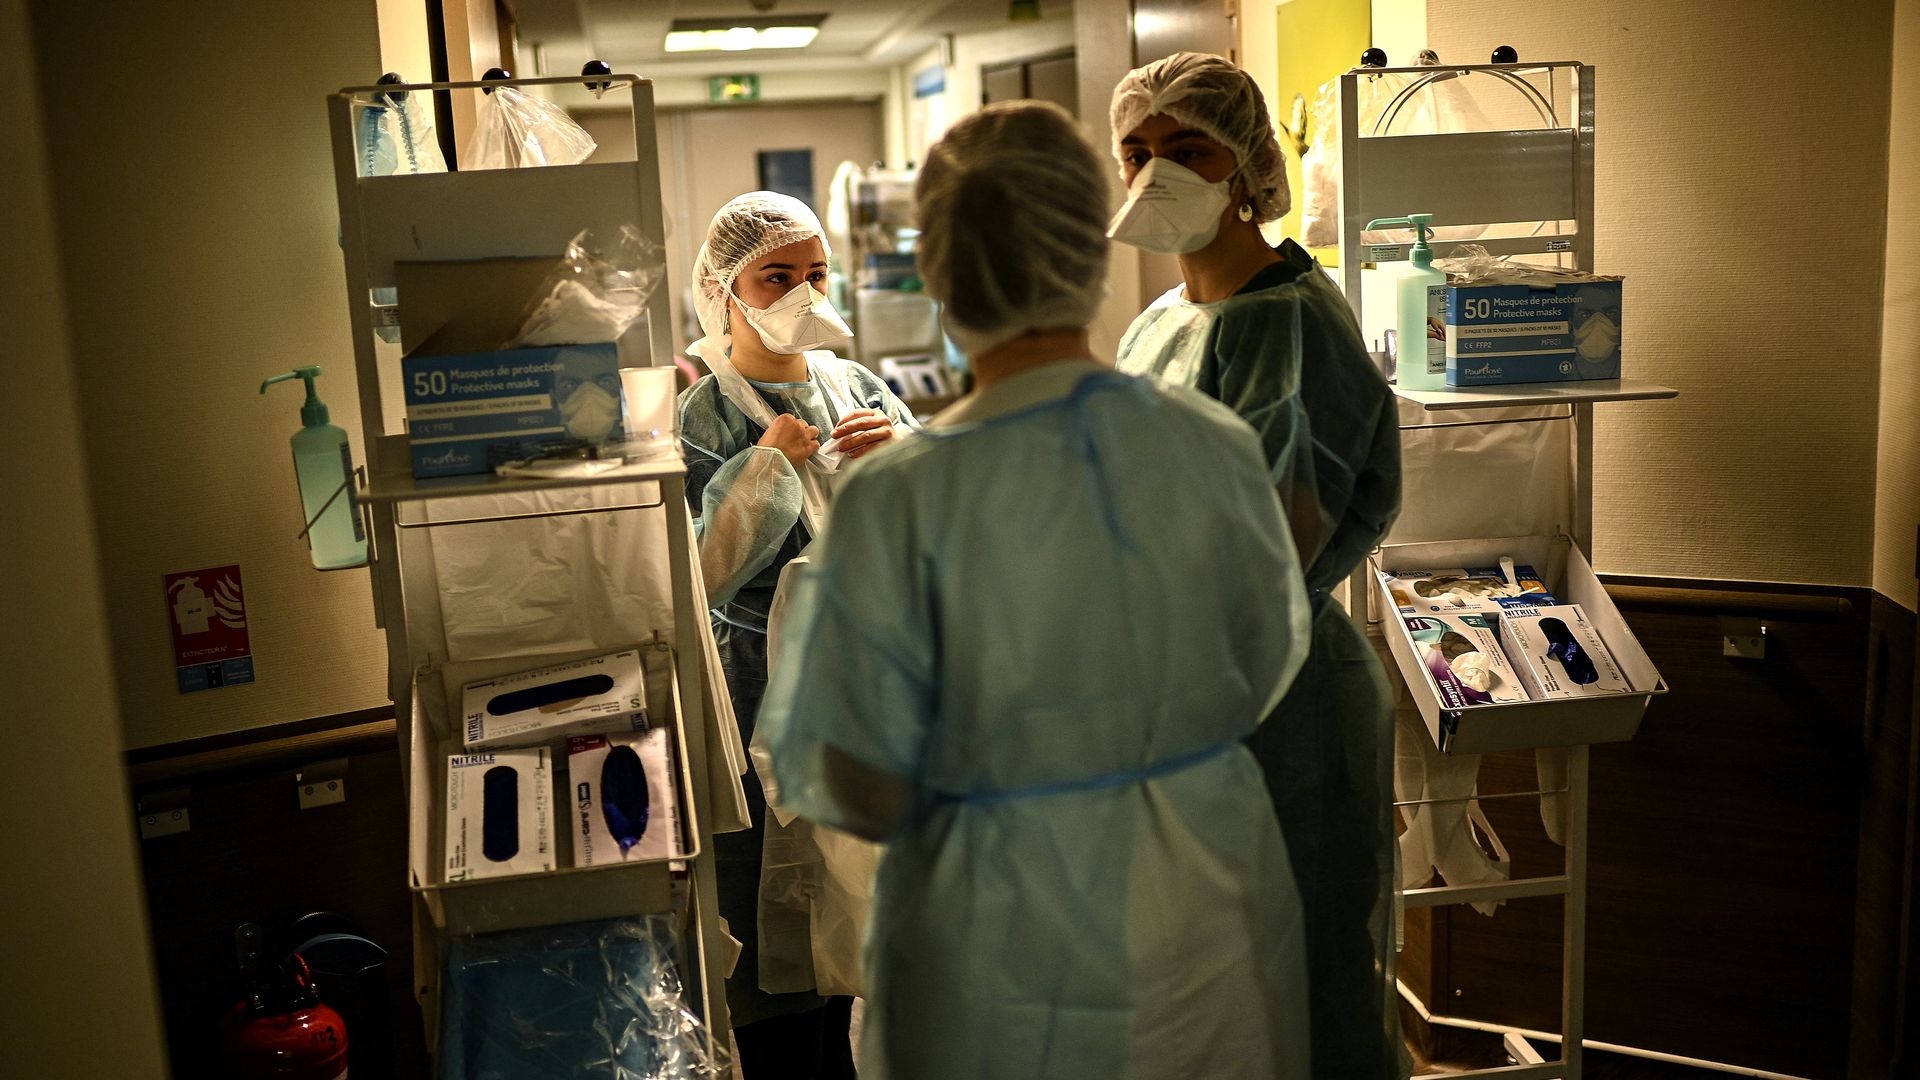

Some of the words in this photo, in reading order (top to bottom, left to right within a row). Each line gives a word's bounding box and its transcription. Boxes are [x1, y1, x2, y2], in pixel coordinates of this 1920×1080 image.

[1464, 298, 1490, 319] 50
[1494, 297, 1528, 308] Masques
[1530, 296, 1540, 304] de
[1542, 294, 1583, 306] protection
[1494, 308, 1535, 318] Protective
[1536, 306, 1562, 316] masks
[450, 368, 495, 381] Masques
[497, 365, 510, 377] de
[512, 362, 565, 376] protection
[414, 370, 447, 396] 50
[450, 380, 505, 394] Protective
[506, 378, 540, 390] masks
[1504, 608, 1540, 617] NITRILE
[630, 698, 640, 708] S
[468, 713, 479, 742] NITRILE
[451, 753, 495, 766] NITRILE
